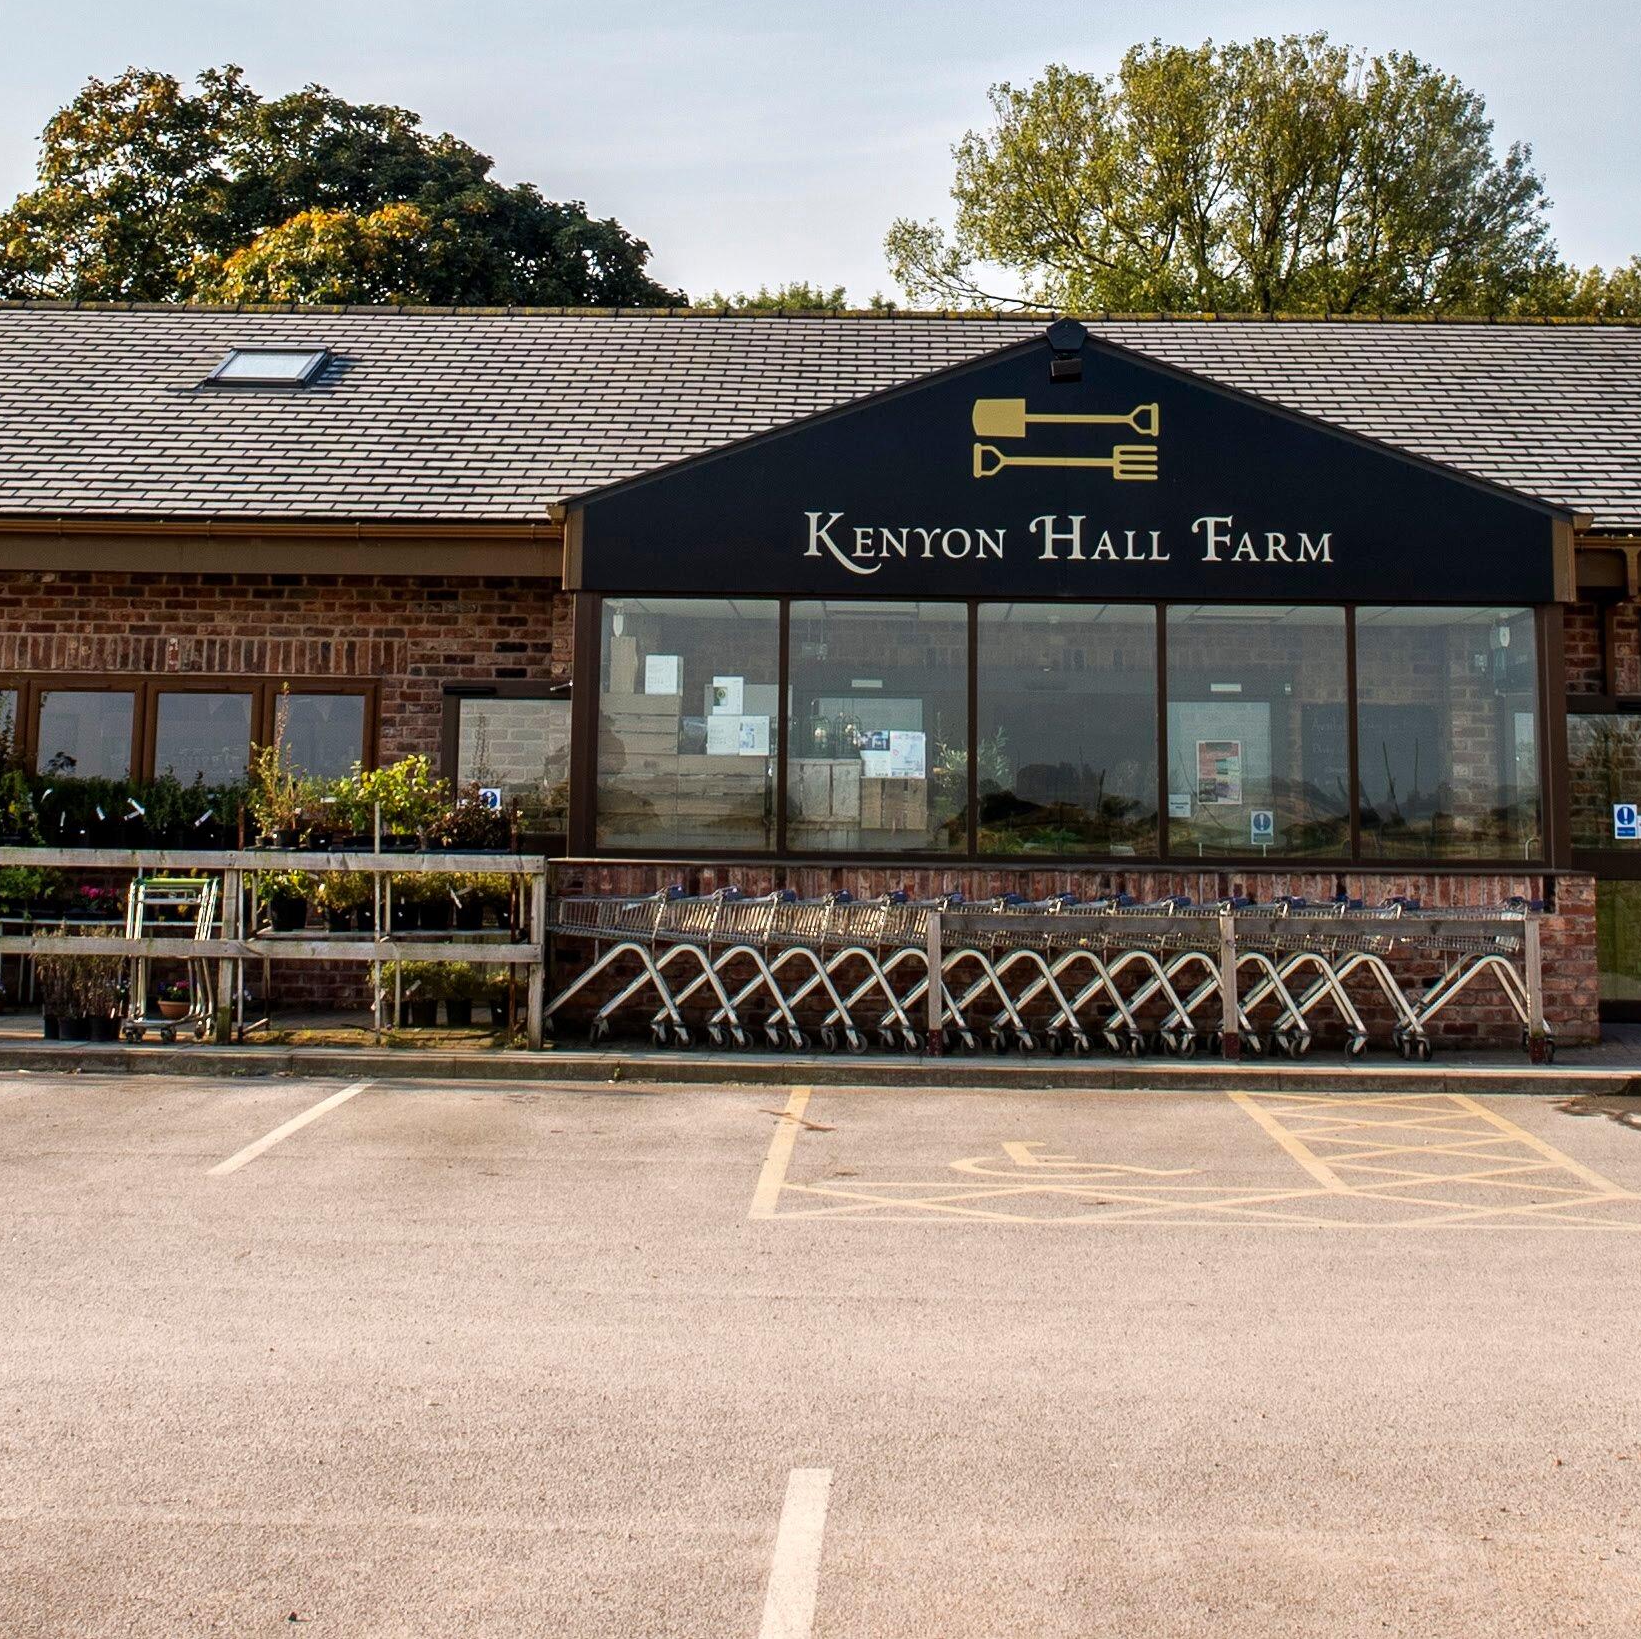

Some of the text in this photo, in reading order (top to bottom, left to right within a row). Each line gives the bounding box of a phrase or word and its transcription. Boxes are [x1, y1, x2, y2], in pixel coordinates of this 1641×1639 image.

[803, 511, 1334, 575] KENYON HALL FARM
